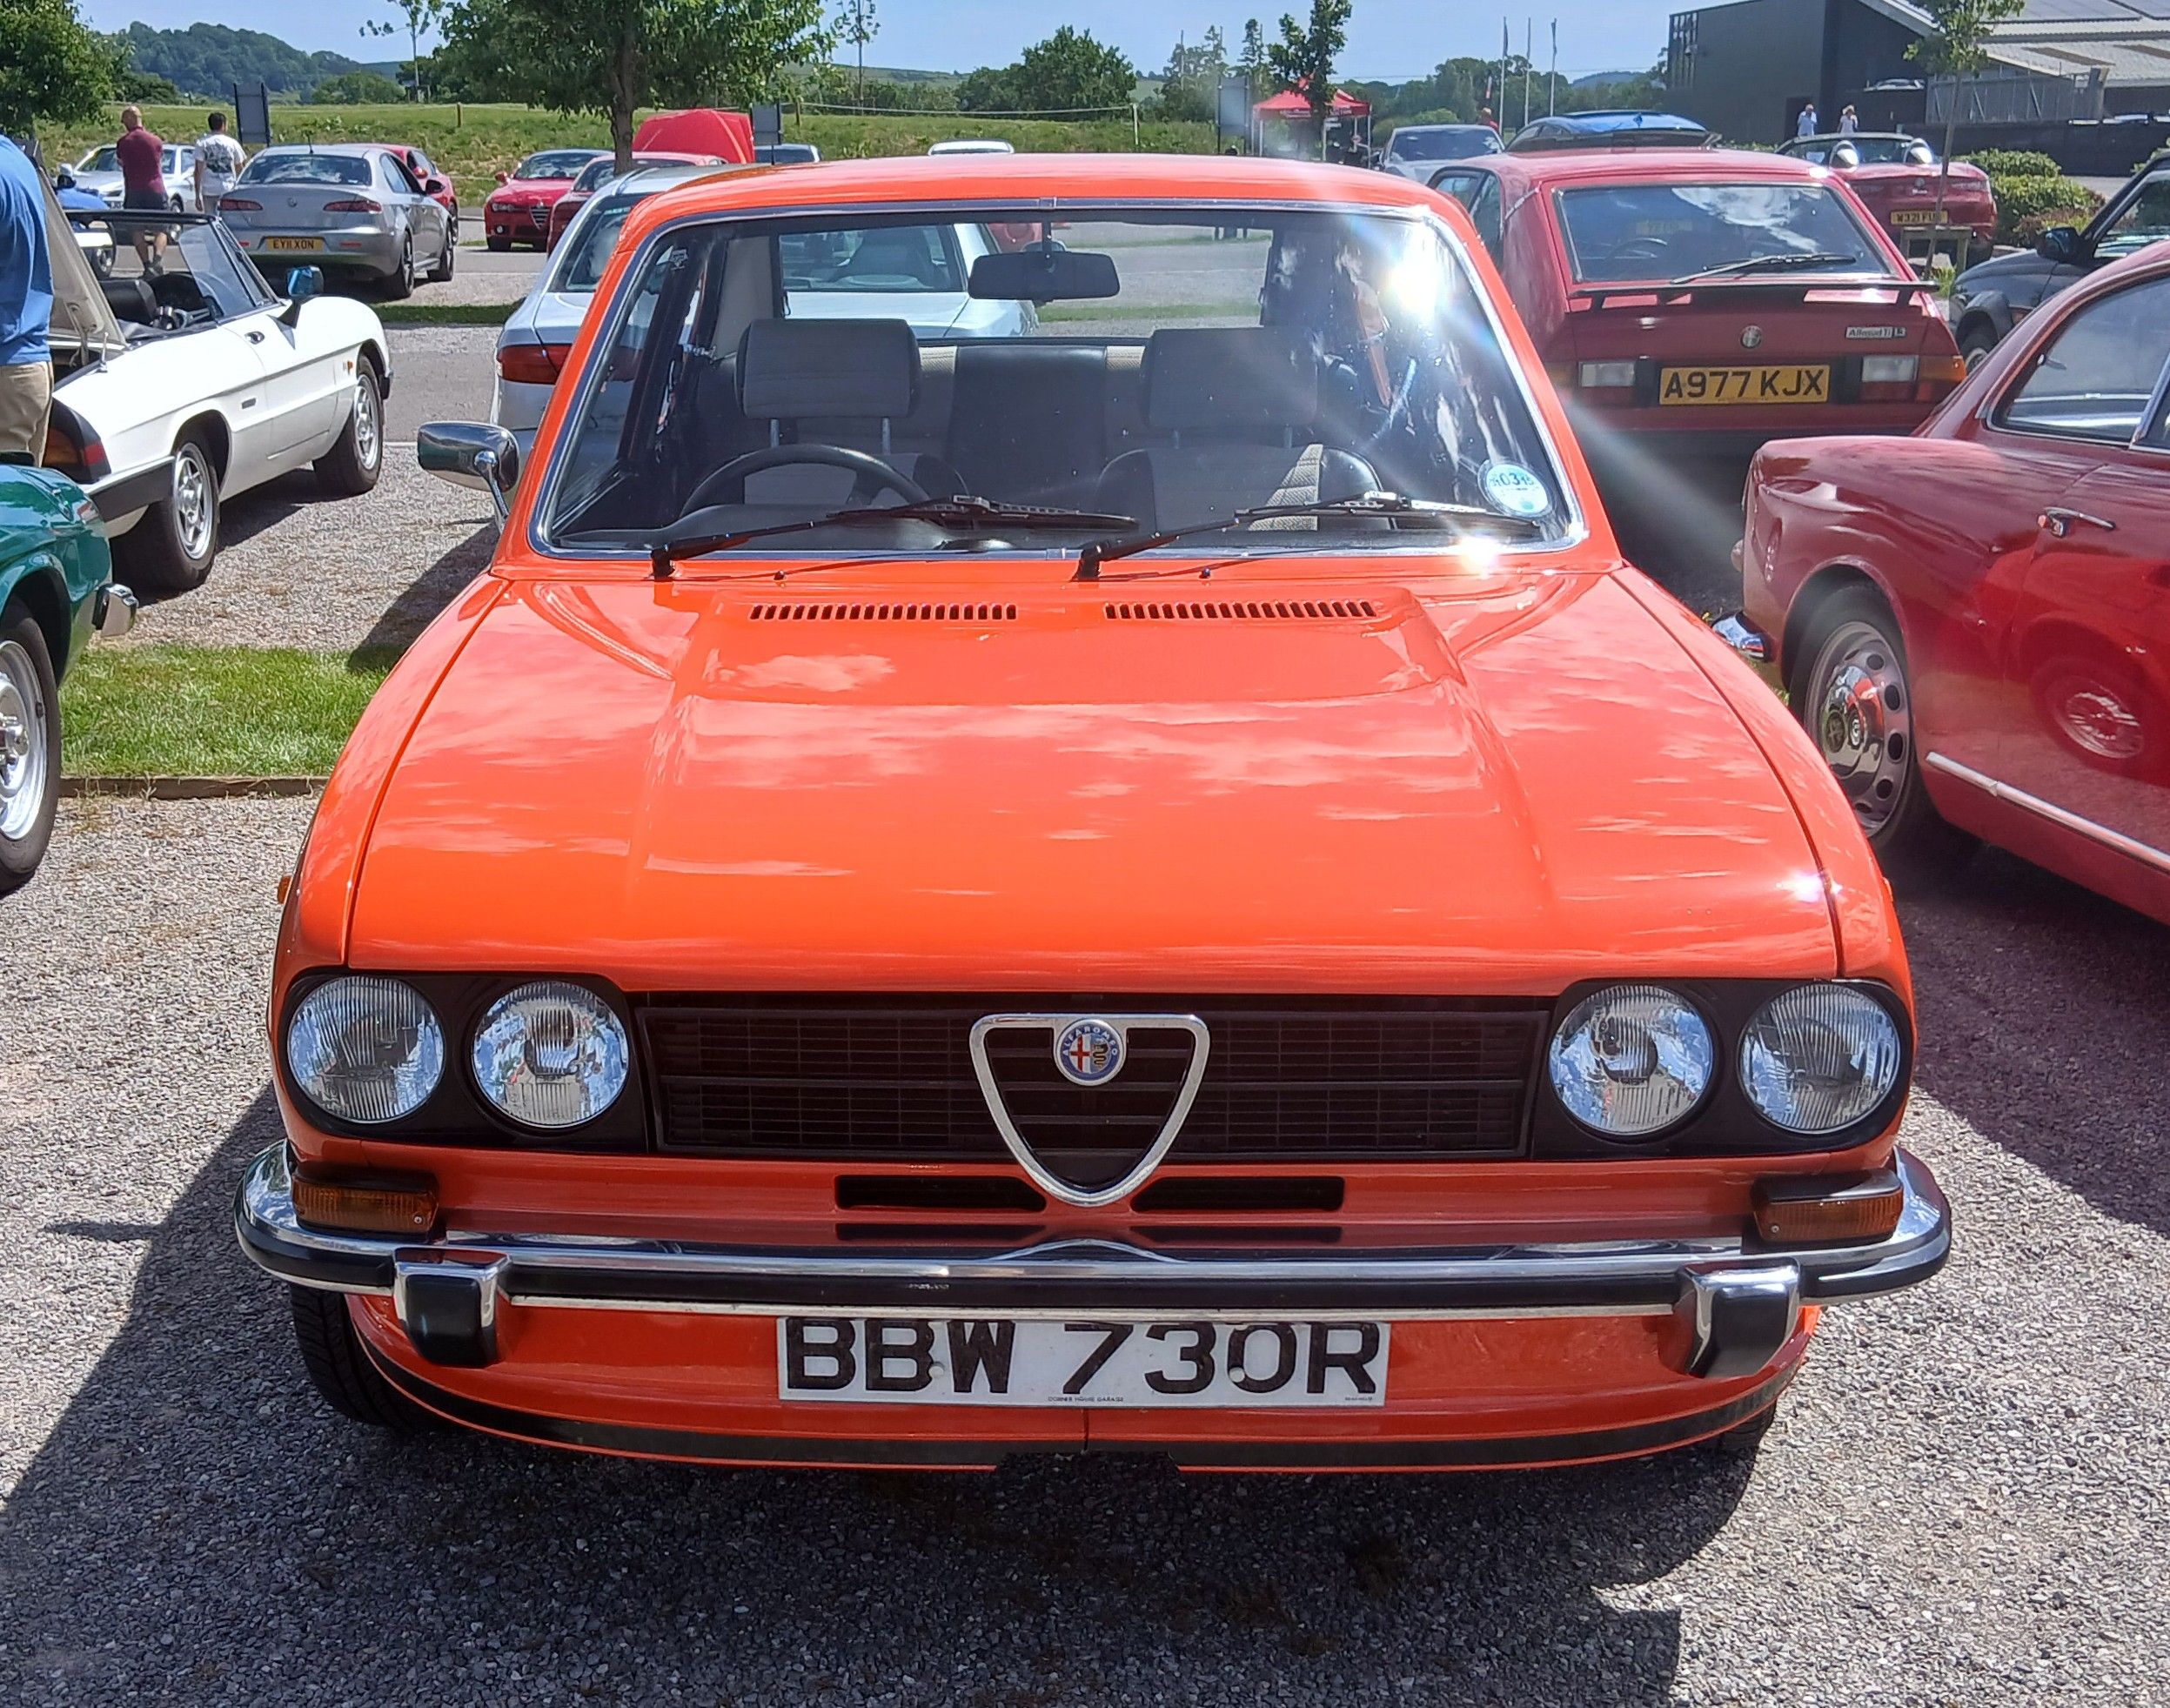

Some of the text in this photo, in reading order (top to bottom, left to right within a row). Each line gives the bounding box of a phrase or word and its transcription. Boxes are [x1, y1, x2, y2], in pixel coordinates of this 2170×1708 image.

[294, 239, 314, 250] XON
[1664, 369, 1825, 399] A977 KJX
[786, 1317, 1380, 1395] BBW 730R
